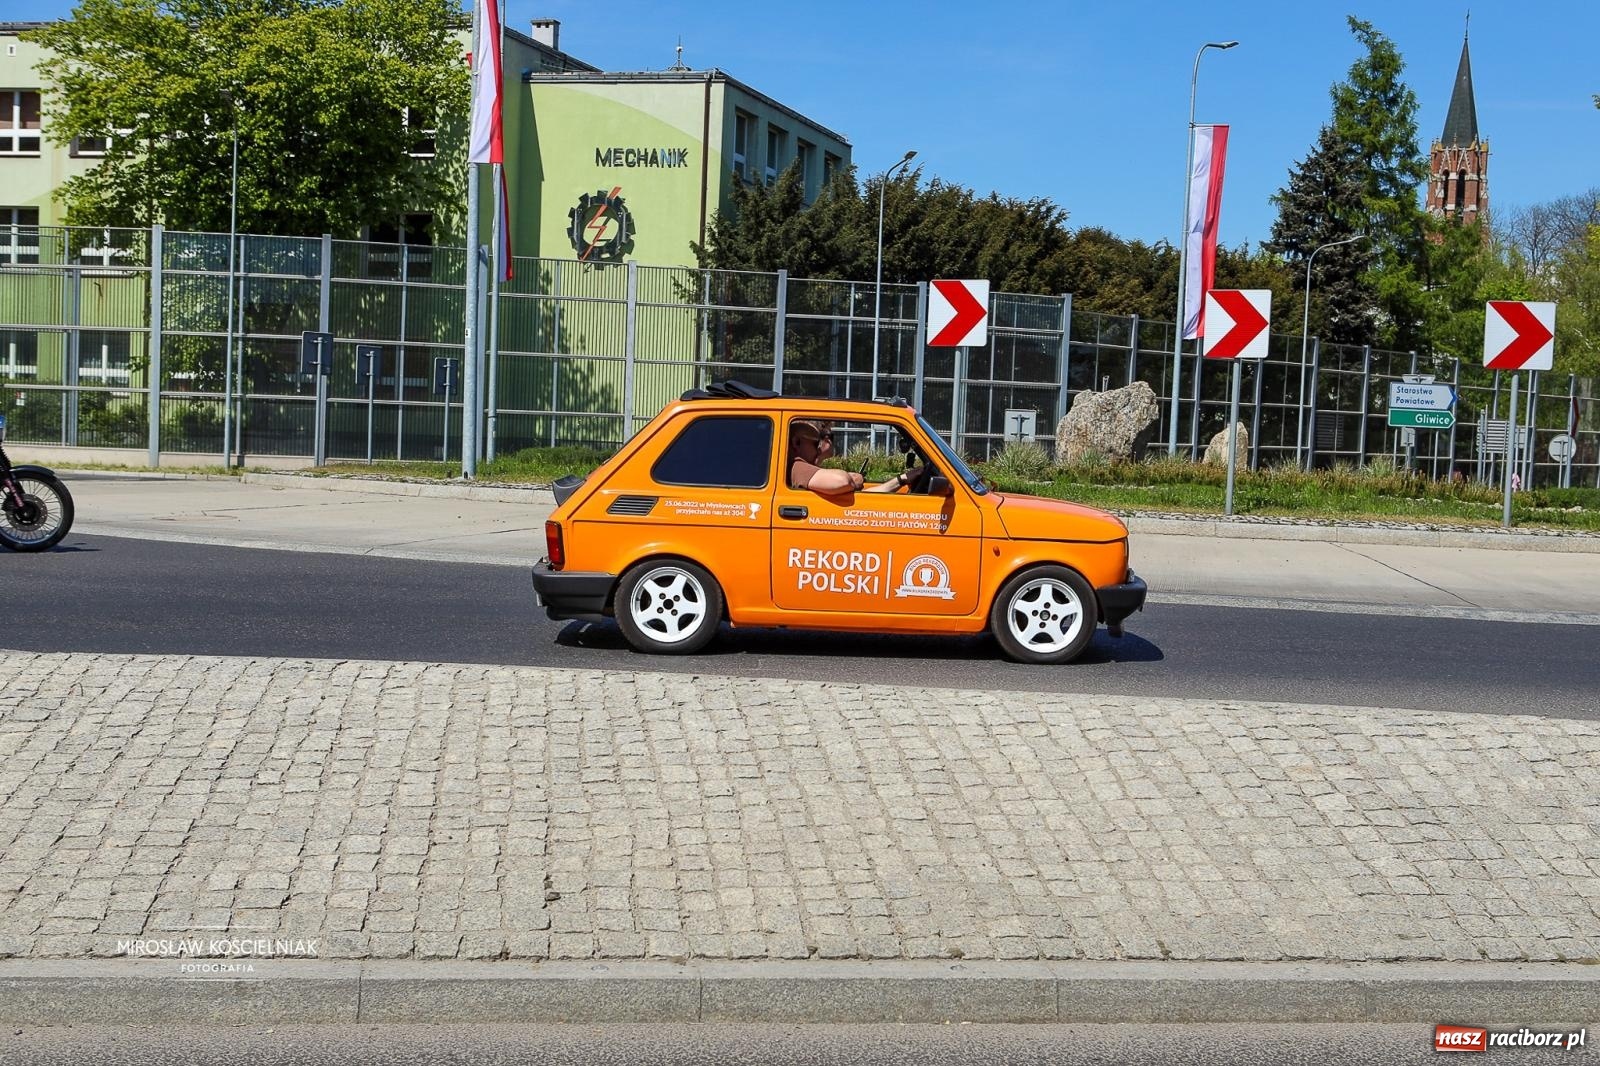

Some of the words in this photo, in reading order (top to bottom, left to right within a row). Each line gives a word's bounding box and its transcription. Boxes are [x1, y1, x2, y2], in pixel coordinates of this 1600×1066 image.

[595, 147, 688, 168] MECHANIK
[1396, 386, 1433, 395] Starostwo
[1395, 397, 1435, 405] Powiatowe
[1415, 414, 1450, 425] Gliwice
[844, 510, 887, 518] UCZESTNIK
[910, 513, 948, 521] REKORDU
[808, 517, 869, 526] NAJWIĘKSZEGO
[897, 521, 928, 529] FIATÓW
[929, 523, 948, 531] 126p
[788, 548, 881, 573] REKORD
[798, 571, 879, 595] POLSKI
